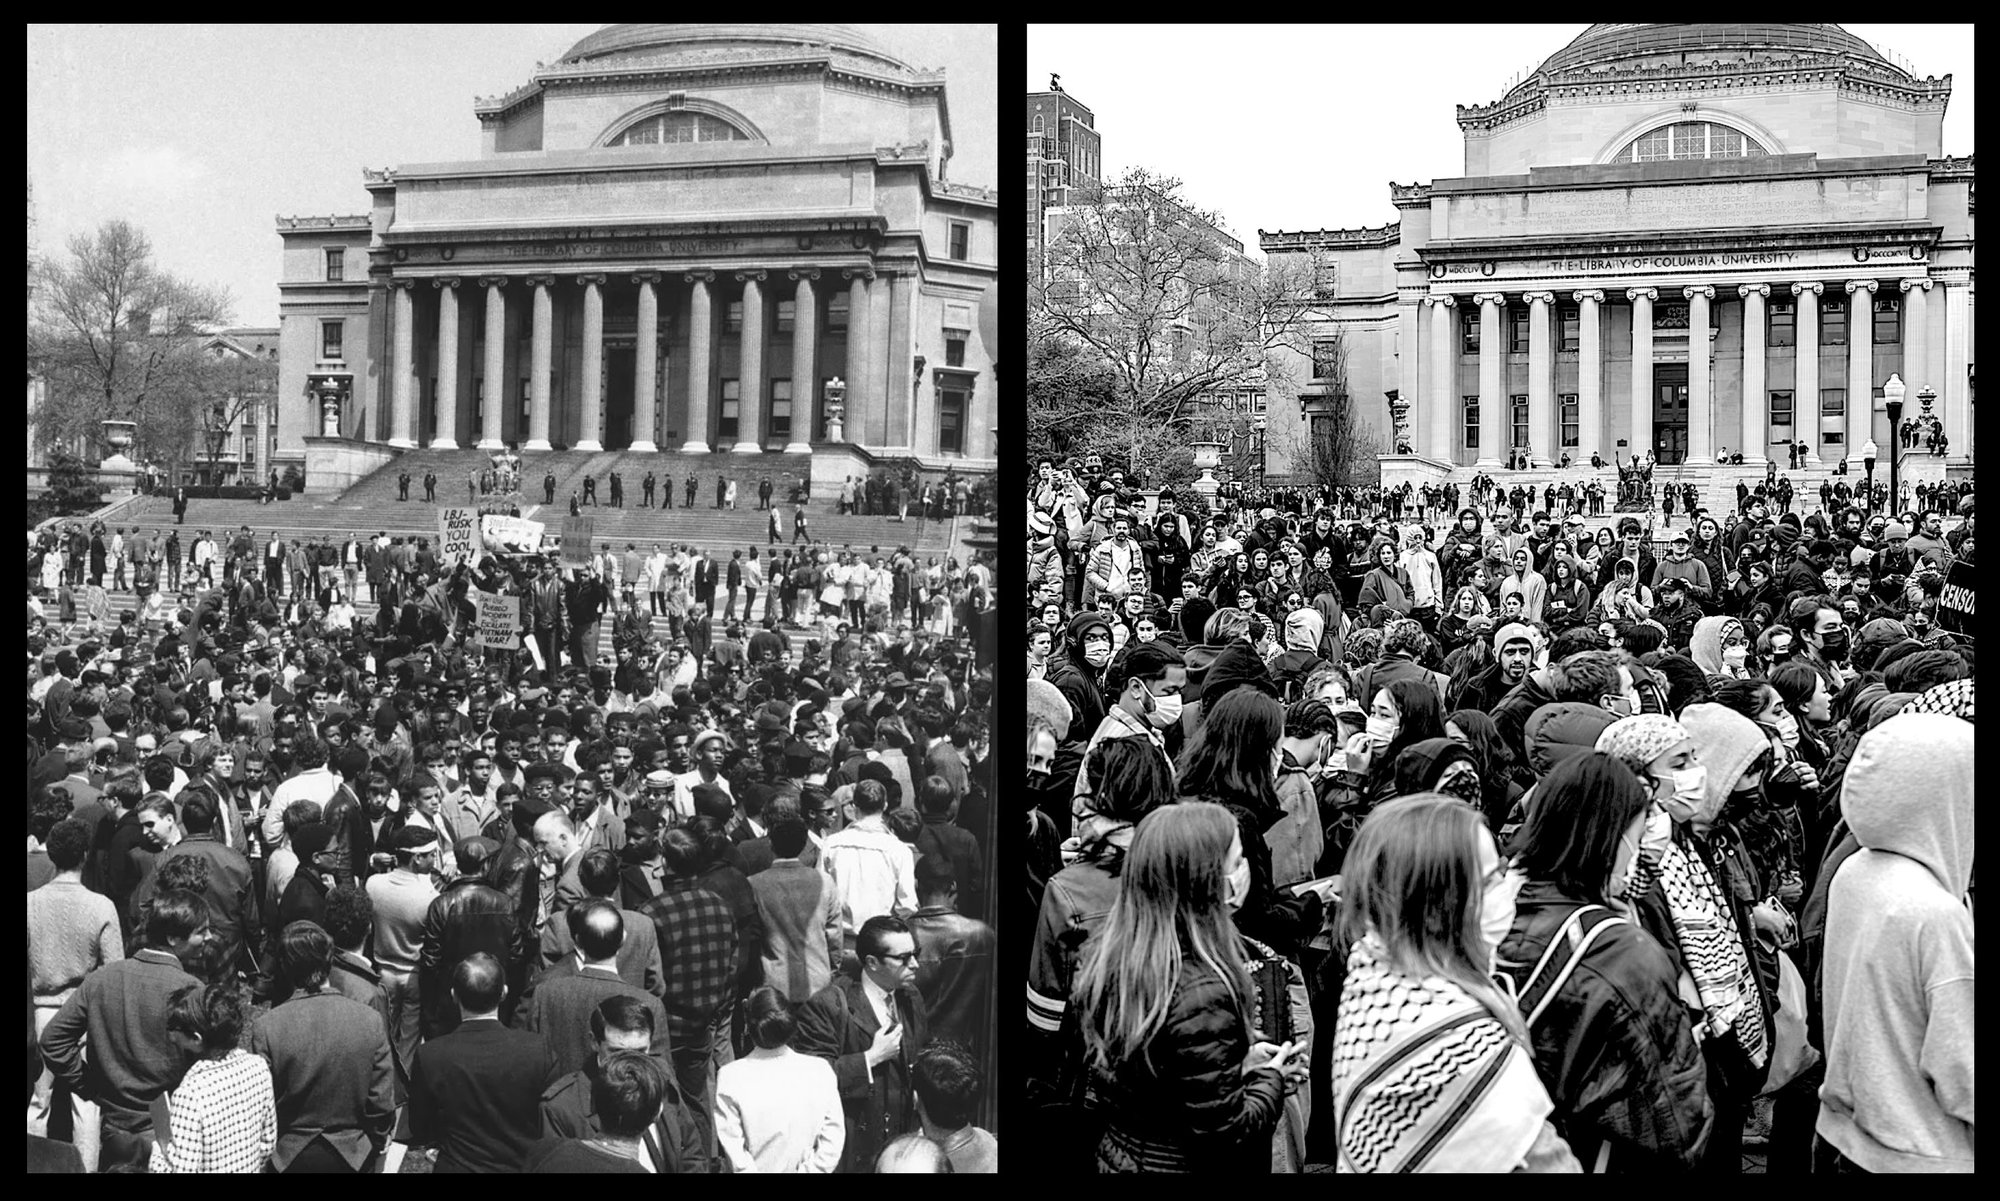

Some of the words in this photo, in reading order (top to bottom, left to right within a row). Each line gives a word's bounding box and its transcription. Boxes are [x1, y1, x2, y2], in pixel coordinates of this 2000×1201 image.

[1552, 261, 1573, 271] THE
[1580, 259, 1627, 270] LIBRARY
[1632, 258, 1648, 268] OF
[1654, 255, 1716, 268] COLUMBIA
[1722, 252, 1796, 265] UNIVERSITY
[448, 518, 473, 529] RUSK
[446, 529, 471, 541] YOU
[445, 541, 471, 553] COOL
[1940, 583, 1975, 615] CENSO
[485, 635, 511, 645] WAR!
